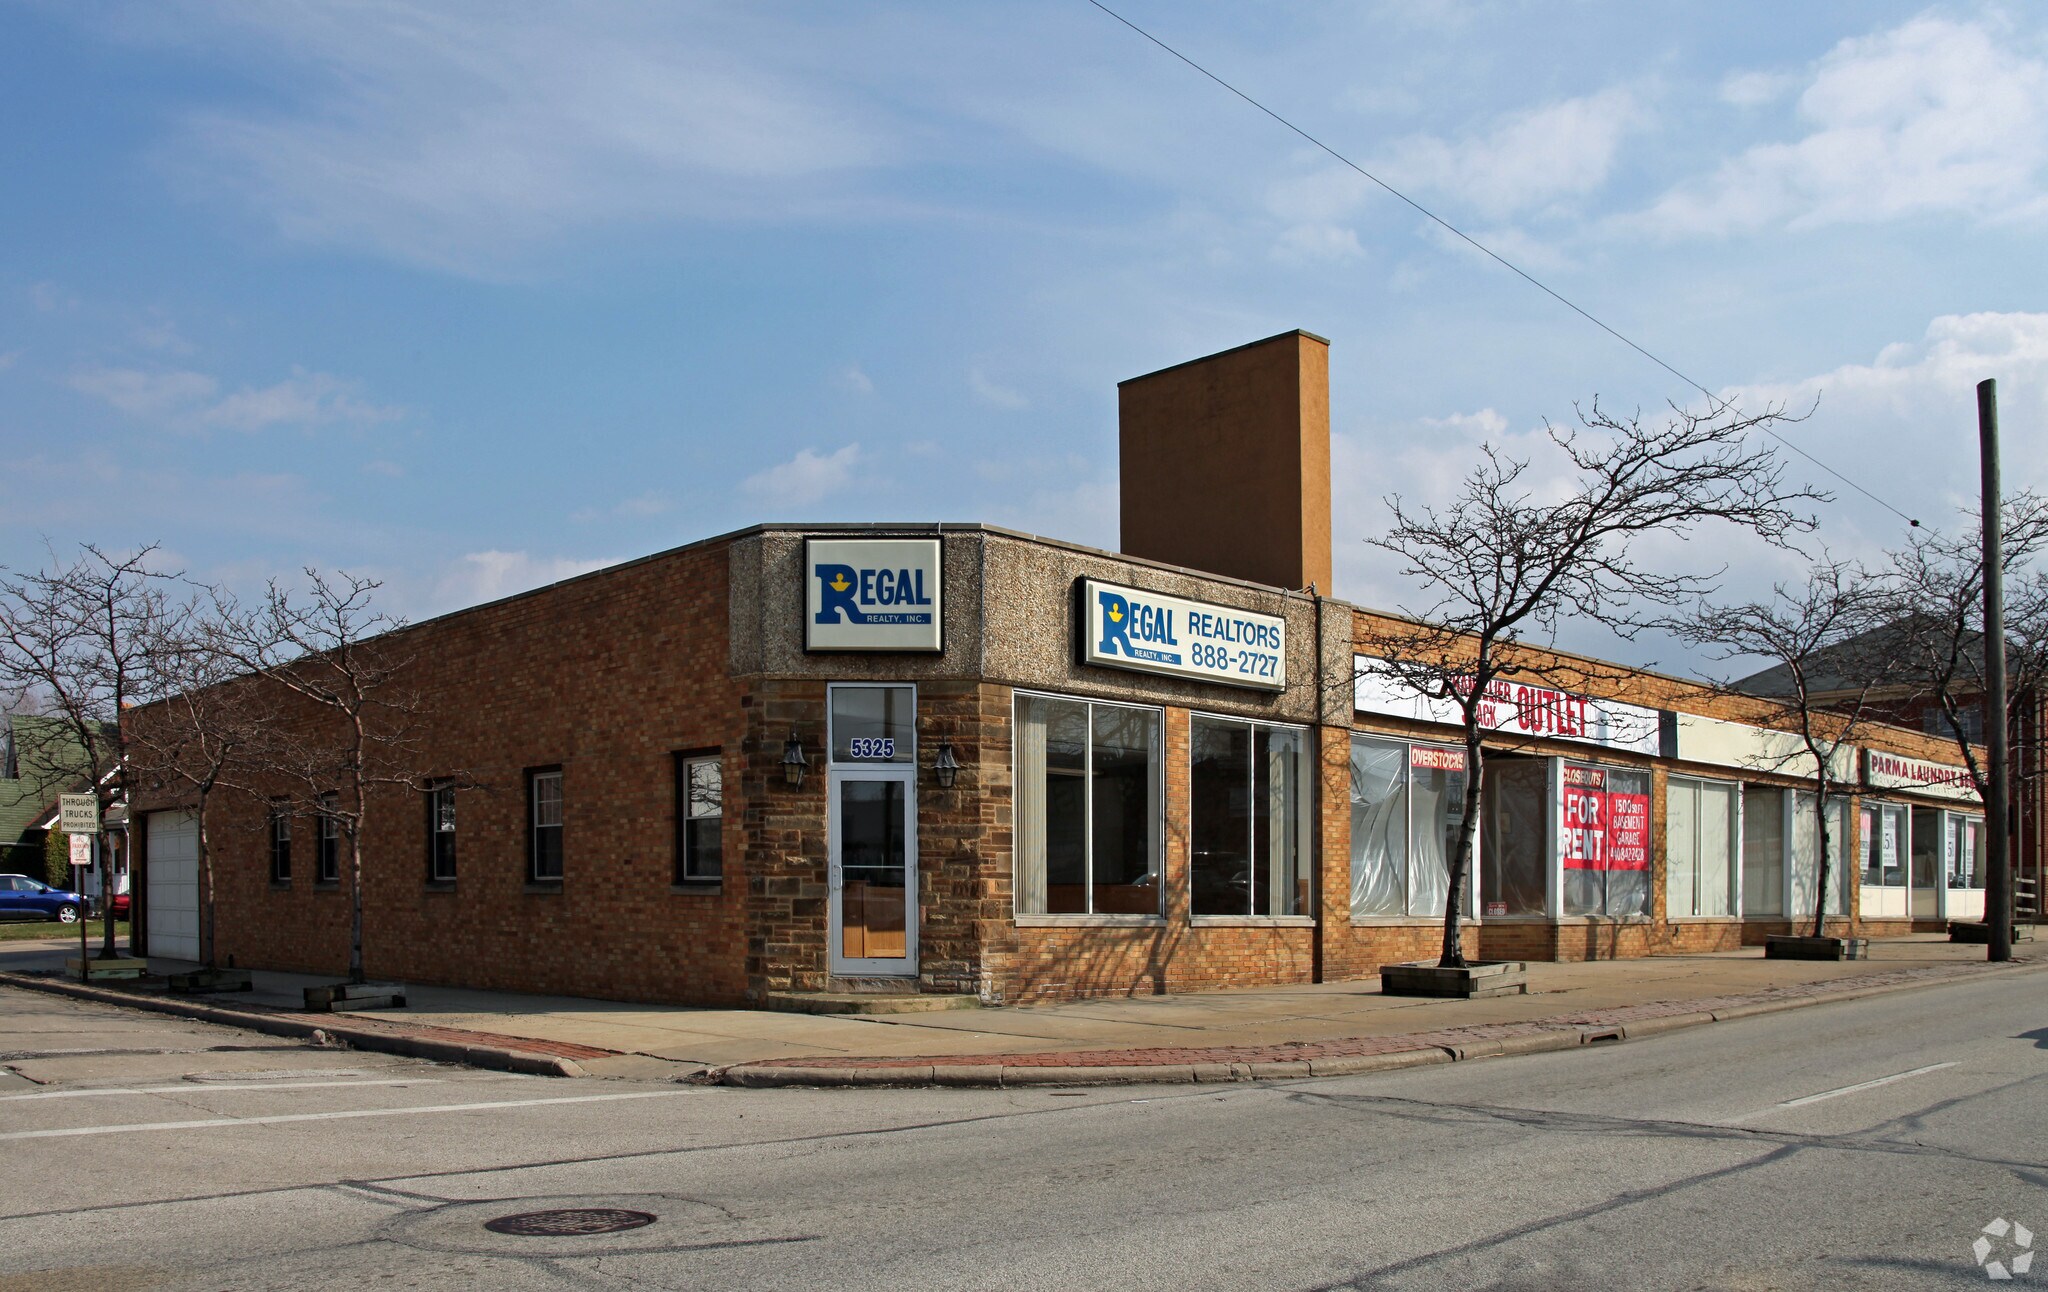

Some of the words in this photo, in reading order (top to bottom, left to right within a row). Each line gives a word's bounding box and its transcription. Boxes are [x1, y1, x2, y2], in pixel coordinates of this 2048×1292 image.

[815, 564, 931, 624] REGAL
[866, 614, 902, 623] REALTY,
[906, 614, 925, 623] INC.
[1099, 591, 1178, 656] REGAL
[1189, 611, 1280, 649] REALTORS
[1134, 650, 1159, 662] REALTY,
[1161, 654, 1175, 663] INC.
[1191, 642, 1278, 678] 888-2727
[1517, 686, 1588, 737] OUTLET
[850, 737, 895, 758] 5325
[1871, 754, 1909, 779] PARMA
[1911, 763, 1957, 787] LAUNDRY
[62, 798, 95, 807] THROUGH
[65, 810, 93, 818] TRUCKS
[1567, 793, 1599, 825] FOR
[1615, 799, 1632, 814] 1500
[1613, 815, 1645, 830] BASEMENT
[1563, 827, 1604, 861] RENT
[1616, 831, 1640, 846] GARAGE
